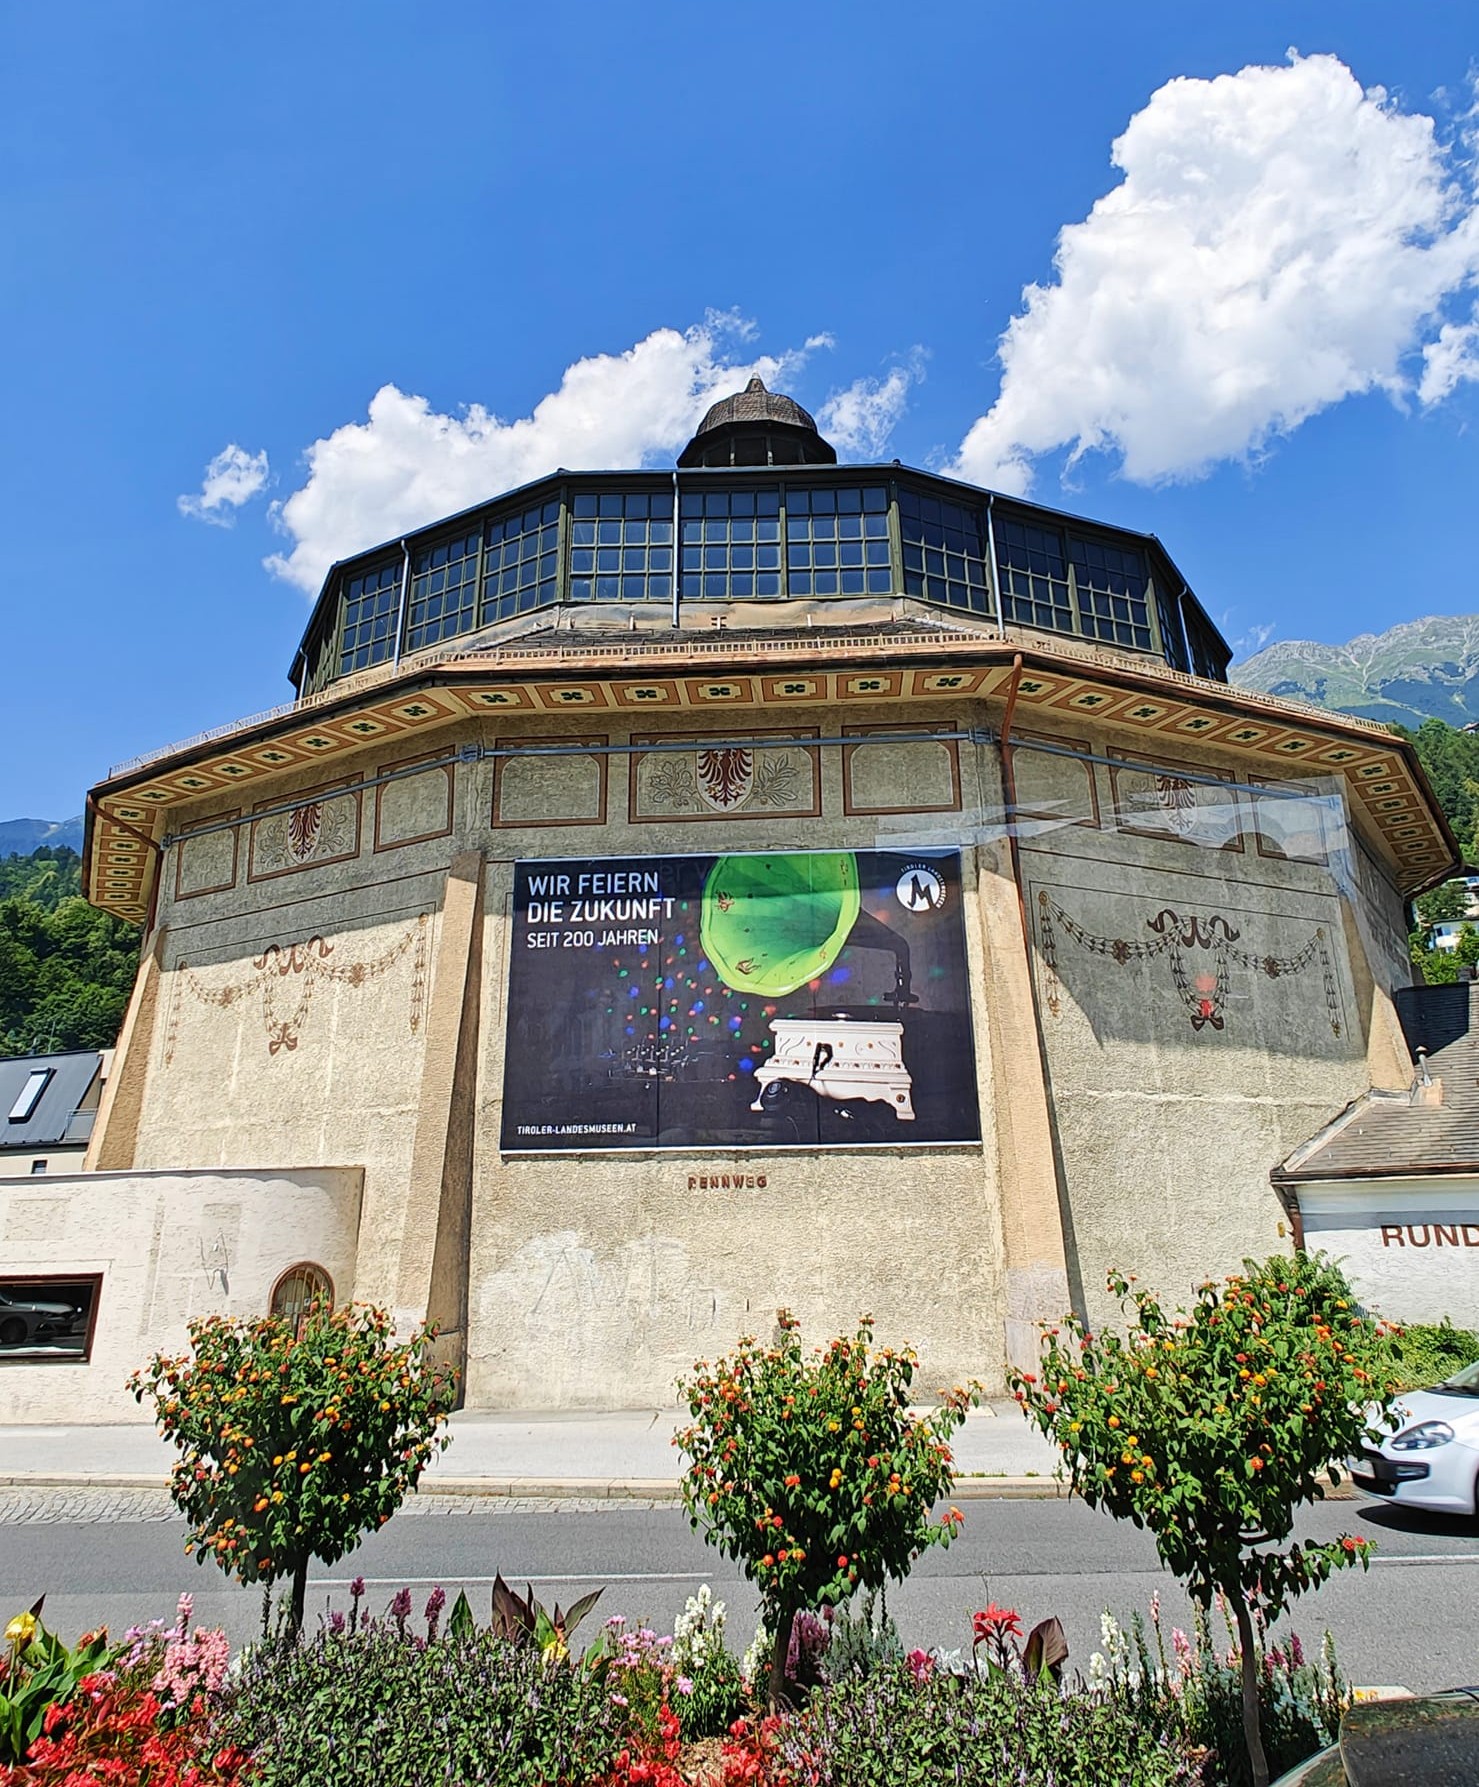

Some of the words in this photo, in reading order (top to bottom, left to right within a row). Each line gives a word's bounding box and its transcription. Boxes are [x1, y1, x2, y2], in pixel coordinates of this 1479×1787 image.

[527, 875, 570, 896] WIR
[578, 872, 659, 895] FEIERN
[527, 902, 563, 924] DIE
[569, 897, 676, 923] ZUKUNFT
[527, 931, 560, 949] SEIT
[563, 930, 594, 948] 200
[597, 928, 659, 947] JAHREN
[517, 1123, 637, 1135] TIROLER-LANDESMUSEEN.AT
